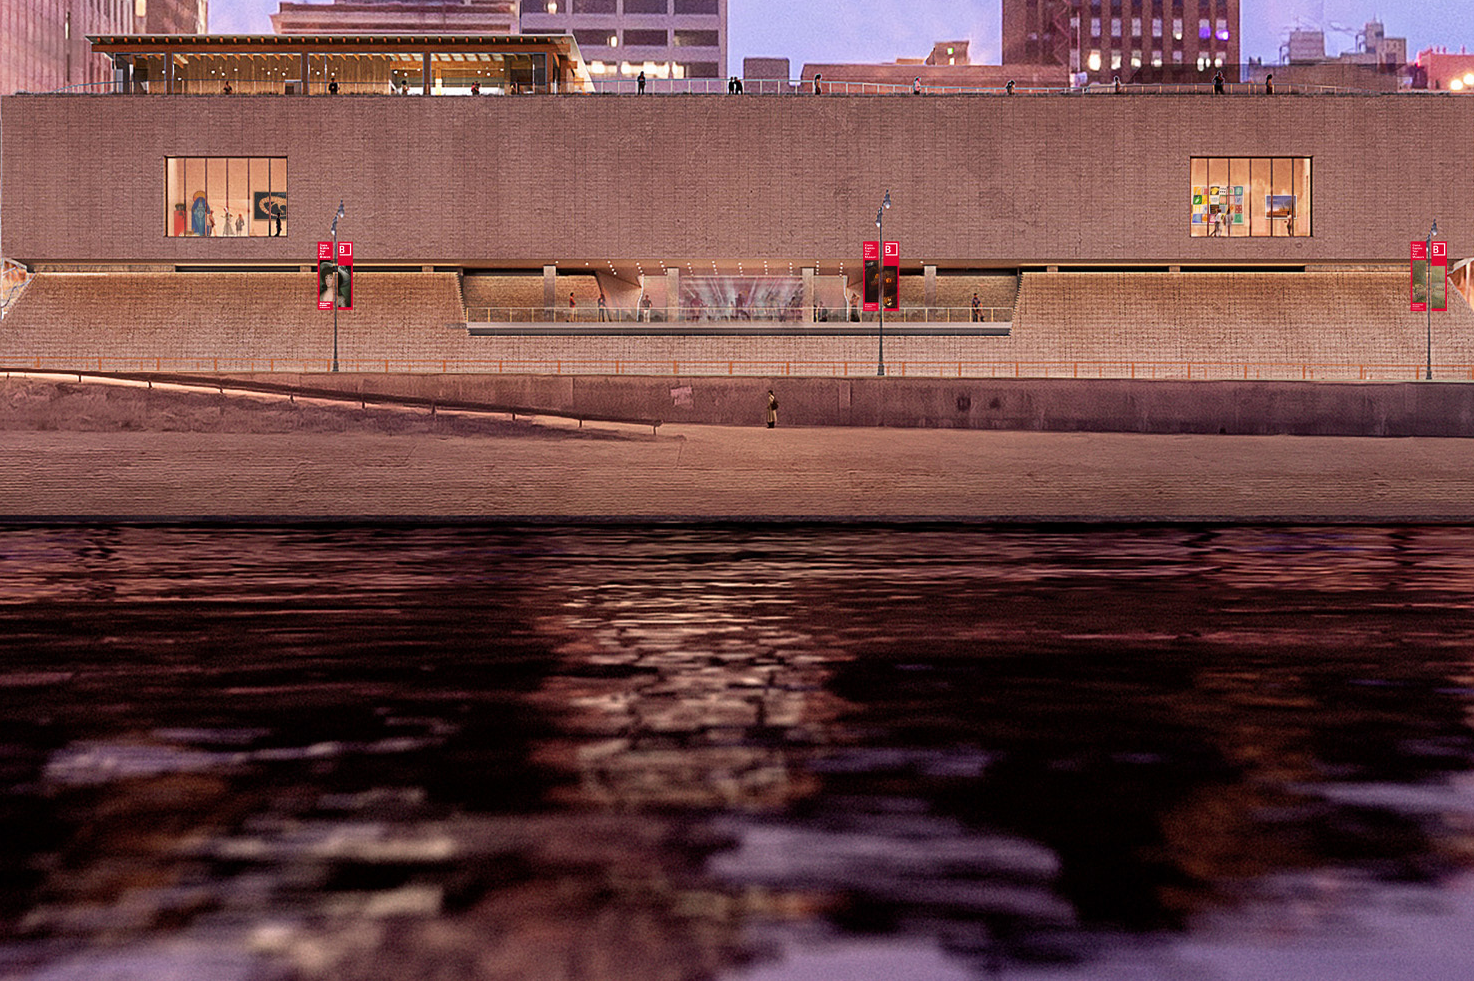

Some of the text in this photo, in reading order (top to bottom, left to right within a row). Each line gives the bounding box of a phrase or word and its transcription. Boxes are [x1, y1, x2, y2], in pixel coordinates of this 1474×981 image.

[339, 245, 345, 254] B
[885, 245, 891, 254] B
[1433, 245, 1439, 254] B
